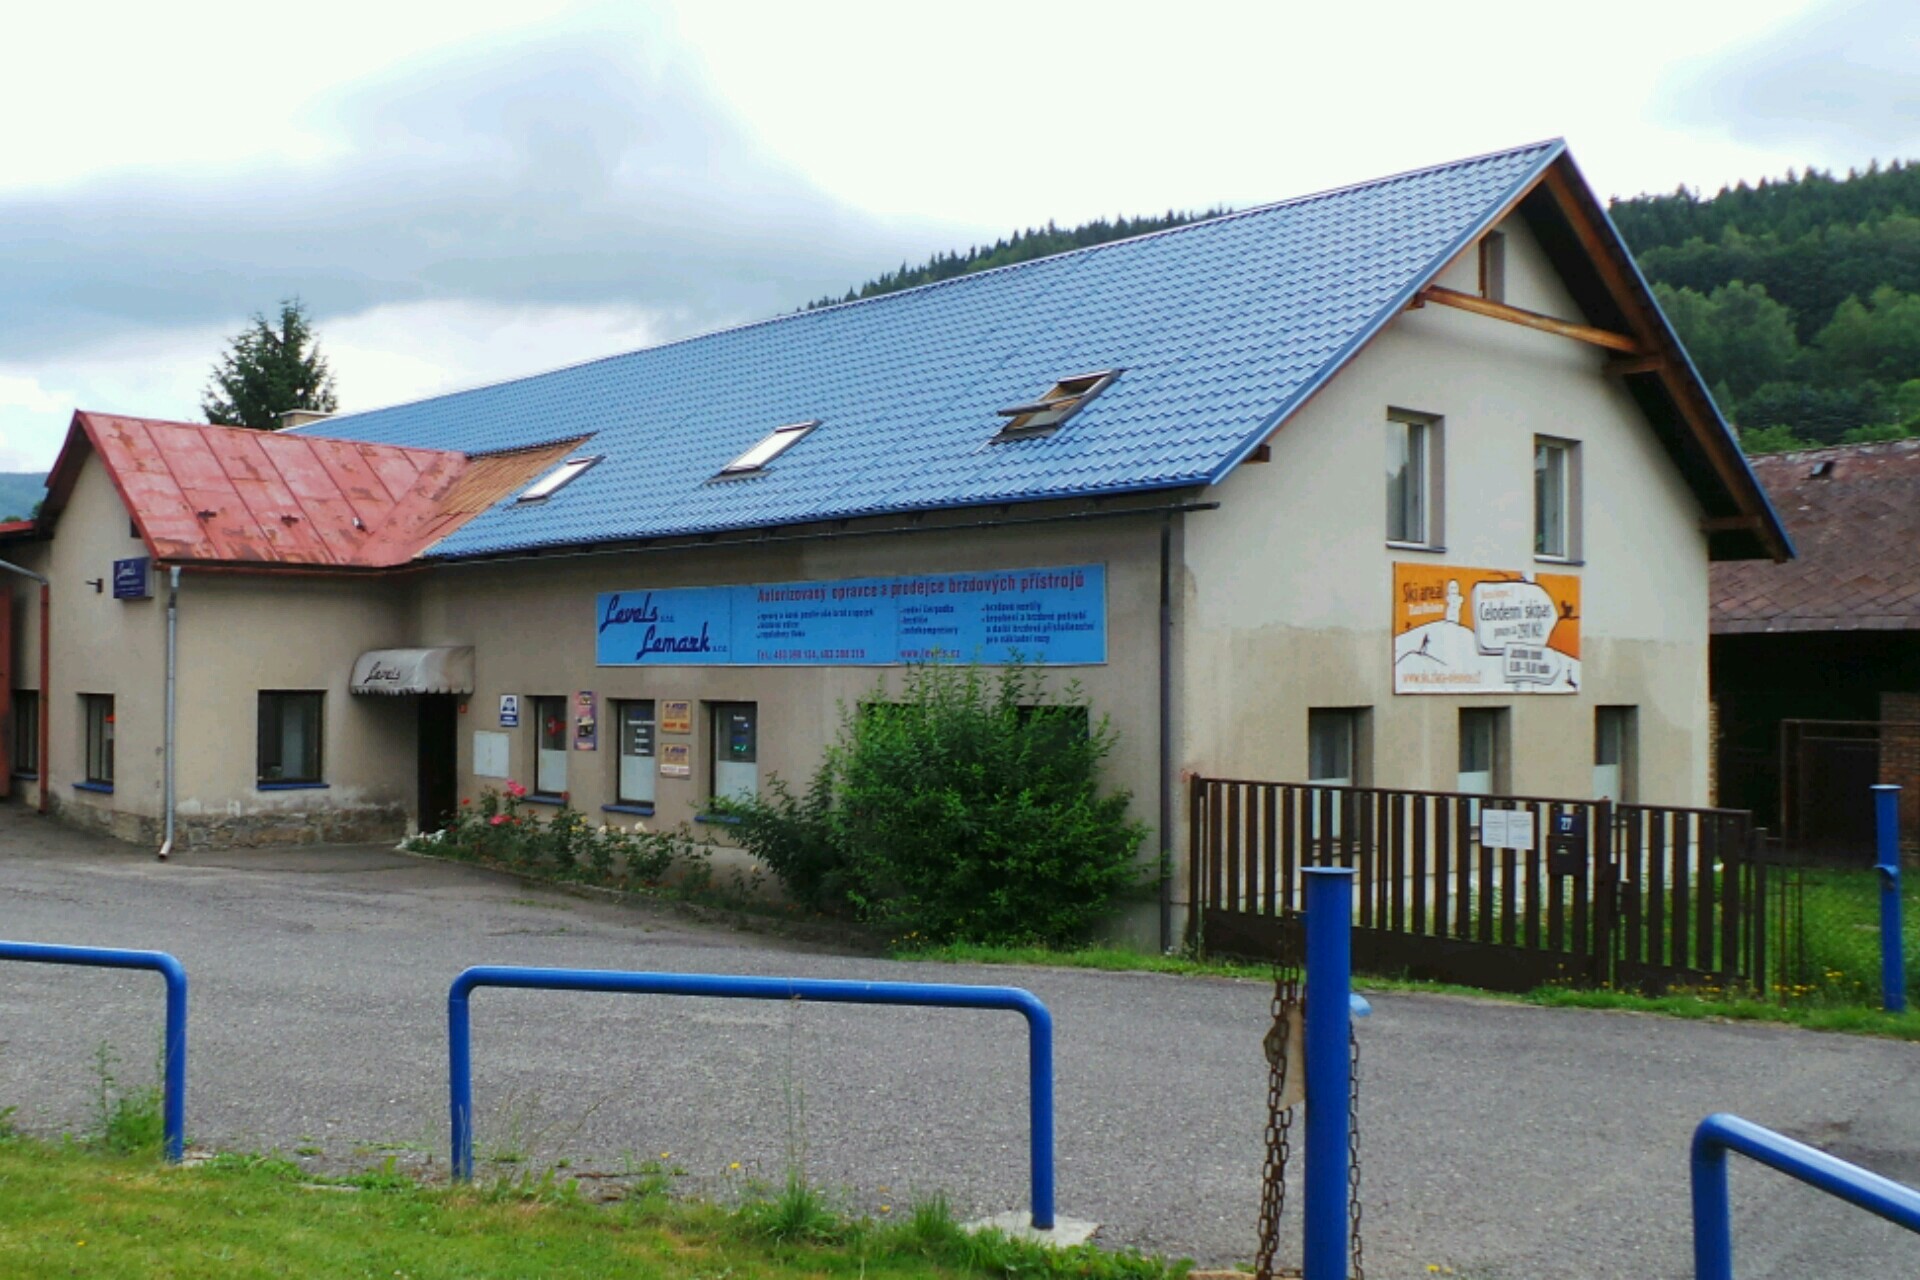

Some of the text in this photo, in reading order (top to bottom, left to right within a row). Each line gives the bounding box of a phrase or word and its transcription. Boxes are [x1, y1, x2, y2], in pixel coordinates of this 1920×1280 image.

[757, 585, 826, 603] Autorizovaný
[831, 584, 877, 602] opravce
[890, 578, 944, 599] prodejce
[949, 574, 1015, 596] brzdových
[1020, 569, 1085, 593] přístrojů
[635, 620, 711, 661] Lemark
[1560, 817, 1573, 831] 27
